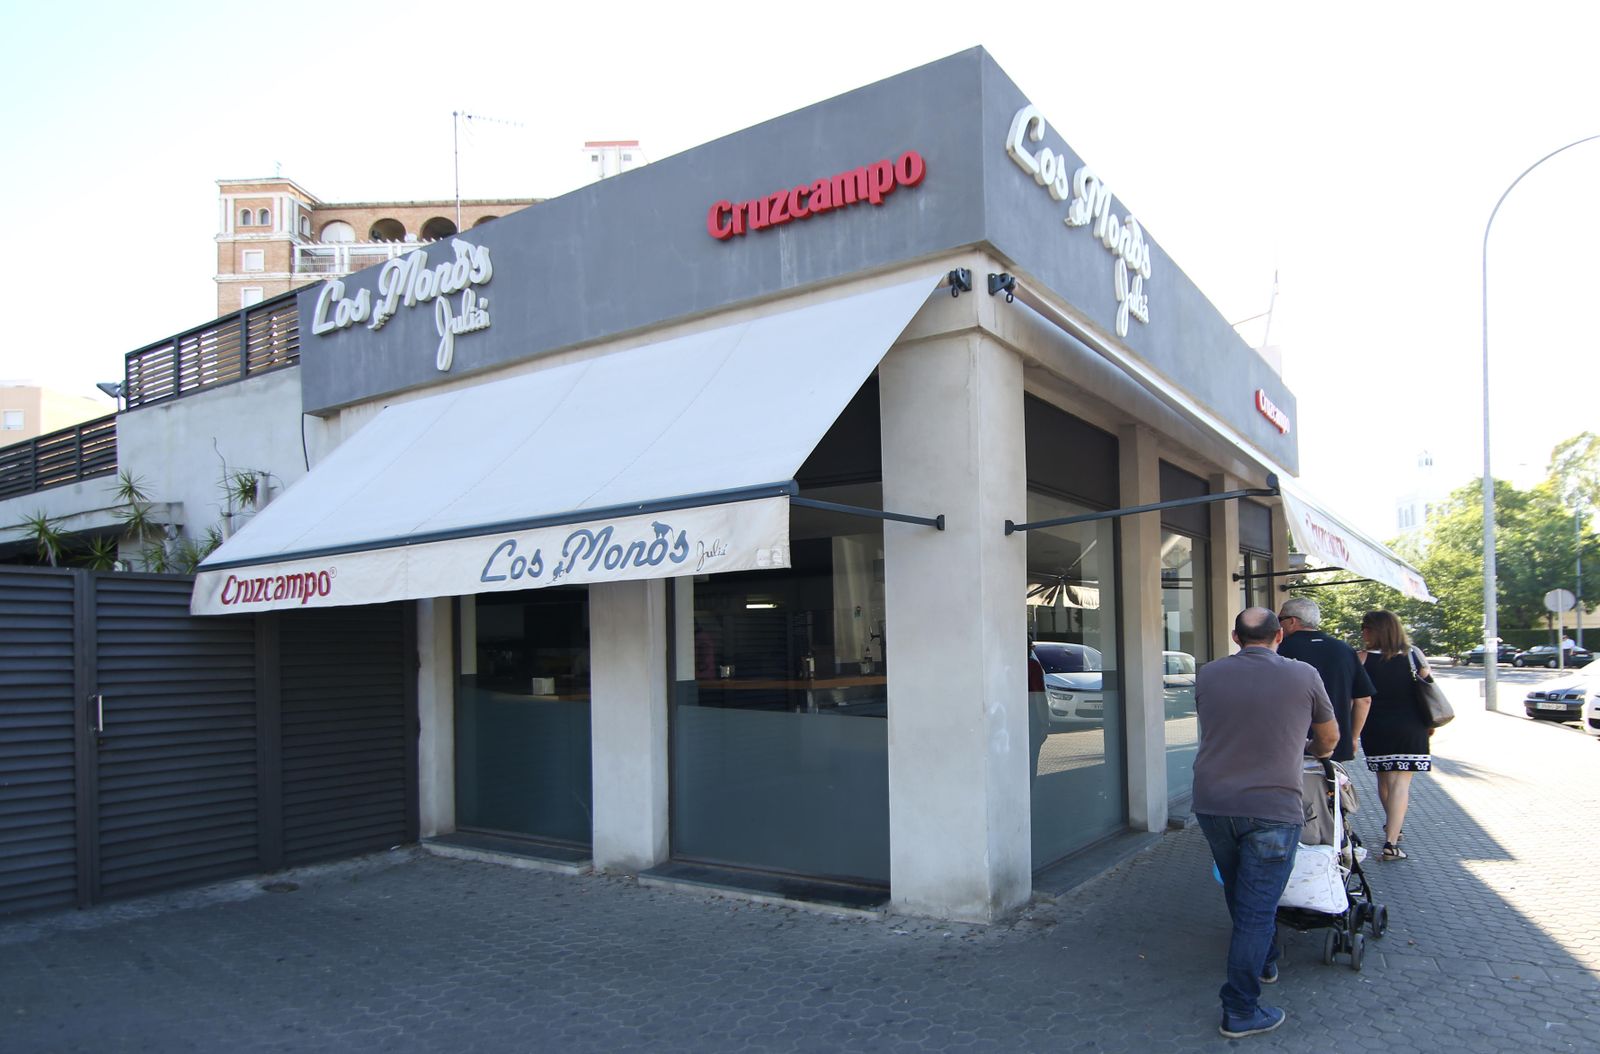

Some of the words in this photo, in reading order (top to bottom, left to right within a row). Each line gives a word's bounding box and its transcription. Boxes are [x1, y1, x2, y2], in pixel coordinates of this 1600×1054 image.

[1006, 104, 1069, 201] Los
[707, 150, 927, 241] Cruzcampo
[312, 280, 371, 336] Los
[480, 538, 544, 583] Los
